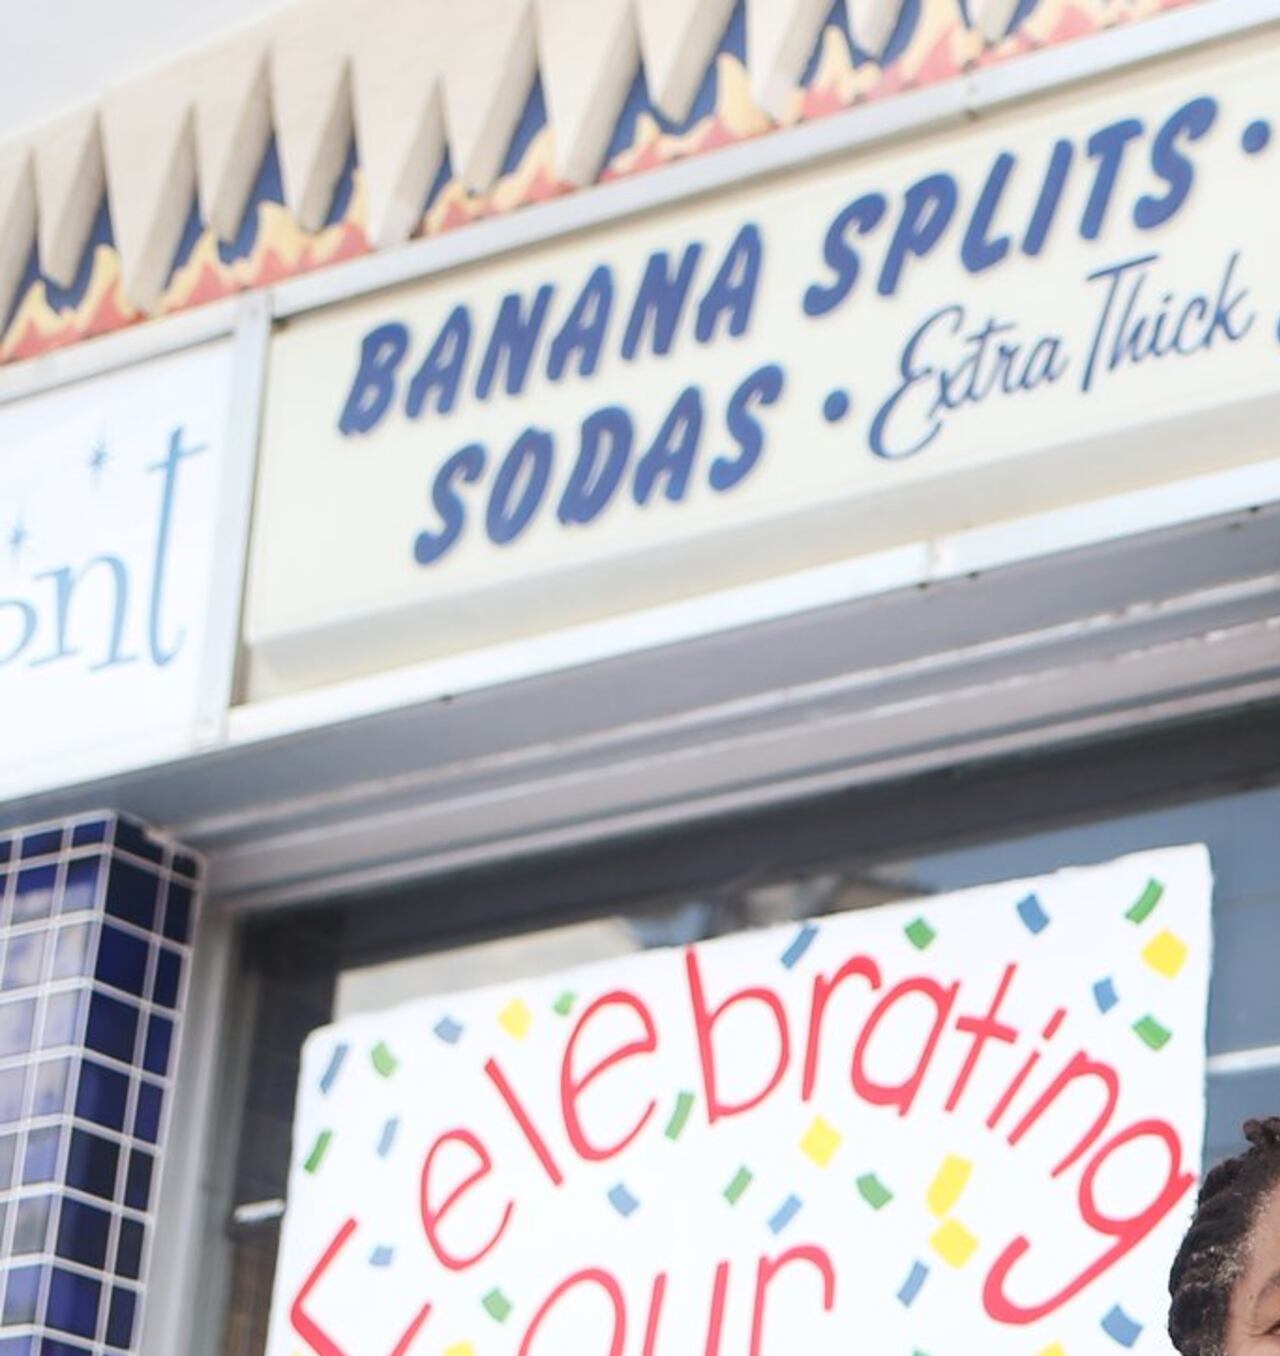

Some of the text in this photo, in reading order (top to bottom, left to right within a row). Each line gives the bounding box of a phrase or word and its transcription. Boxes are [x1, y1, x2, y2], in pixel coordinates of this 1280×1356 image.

[338, 223, 763, 434] BANANA
[804, 97, 1217, 315] SPLITS
[414, 365, 785, 566] SODAS
[868, 305, 1067, 458] Extra
[1081, 251, 1255, 391] Thick
